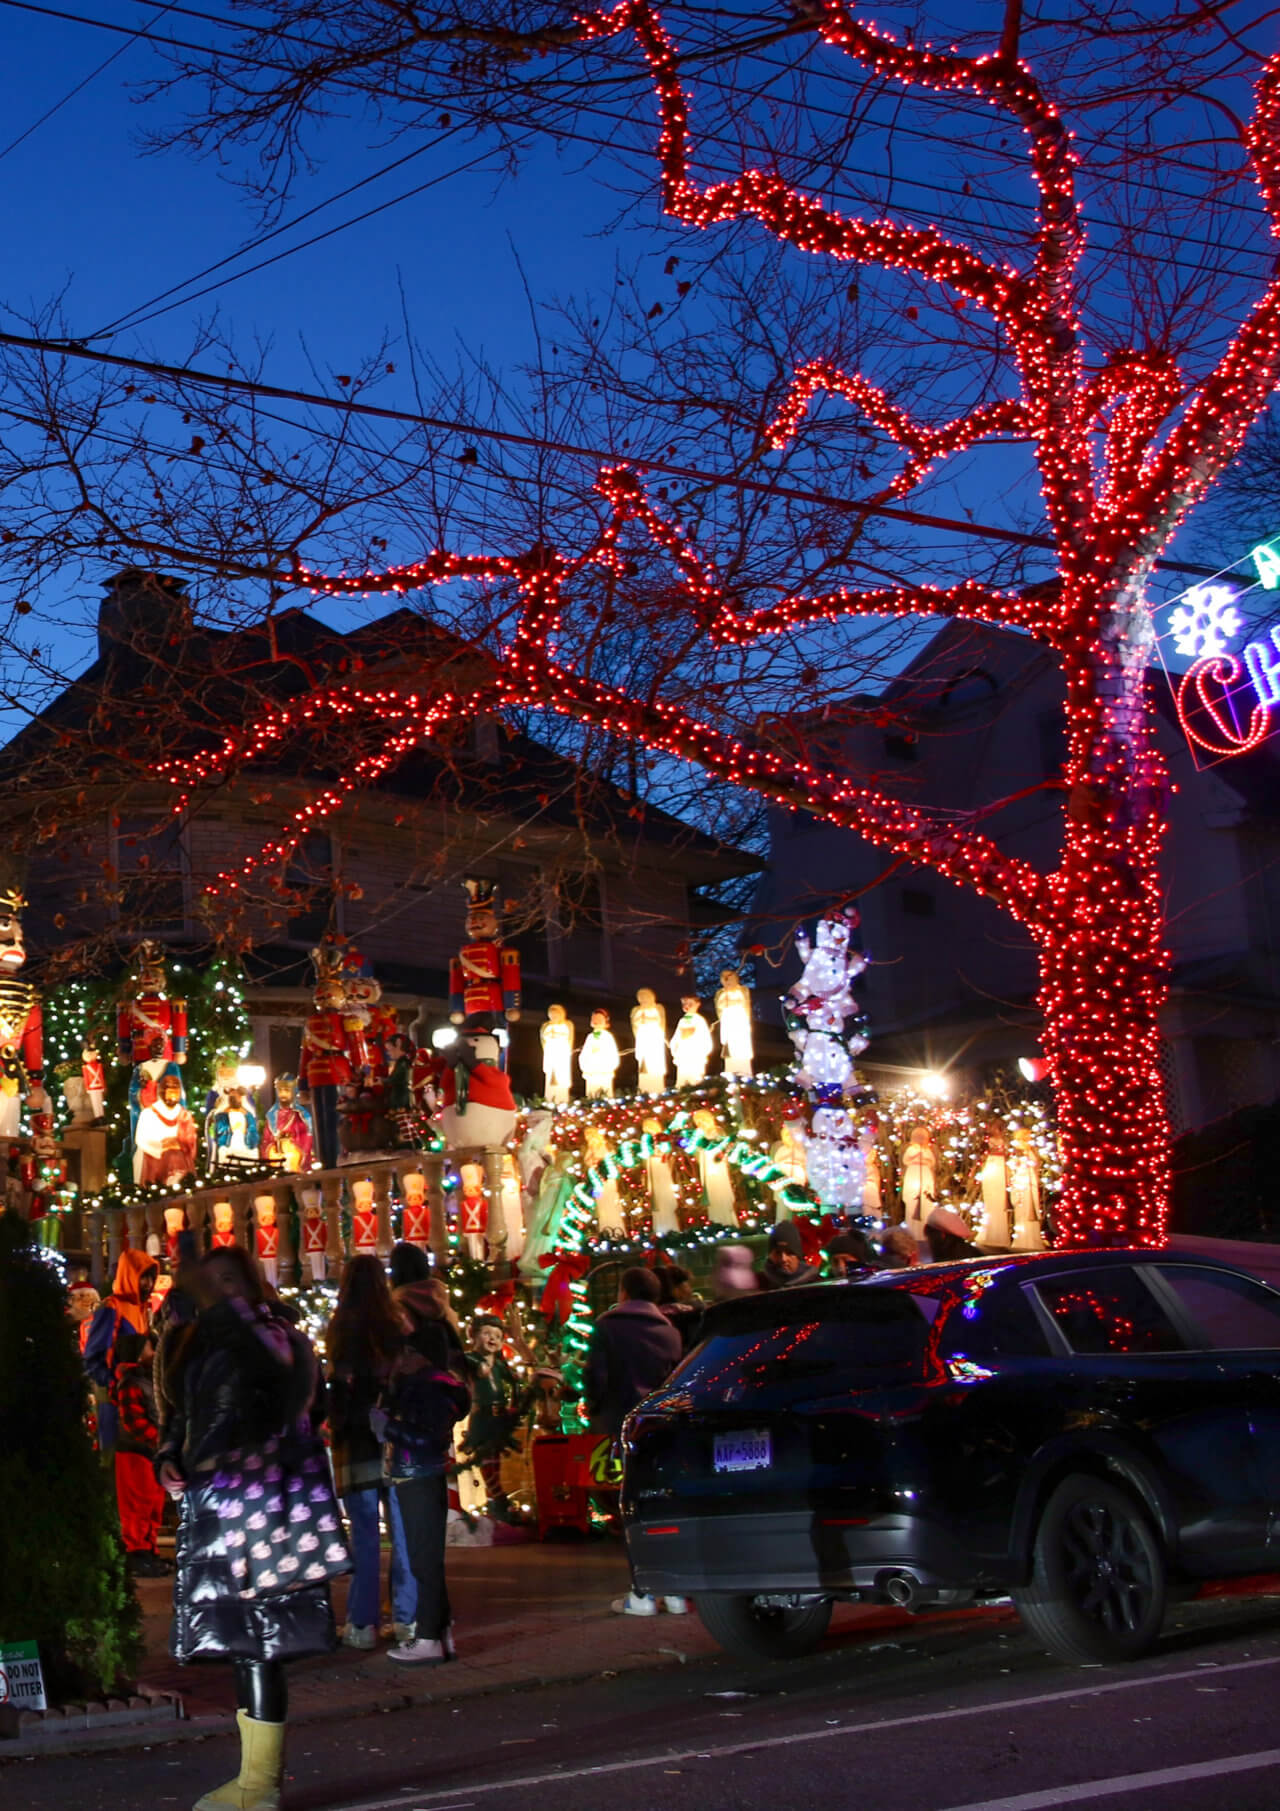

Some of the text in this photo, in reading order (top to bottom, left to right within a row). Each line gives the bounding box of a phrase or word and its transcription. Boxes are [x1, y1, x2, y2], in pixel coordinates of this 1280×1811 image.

[7, 1662, 39, 1679] DO NOT
[10, 1681, 43, 1698] LITTER
